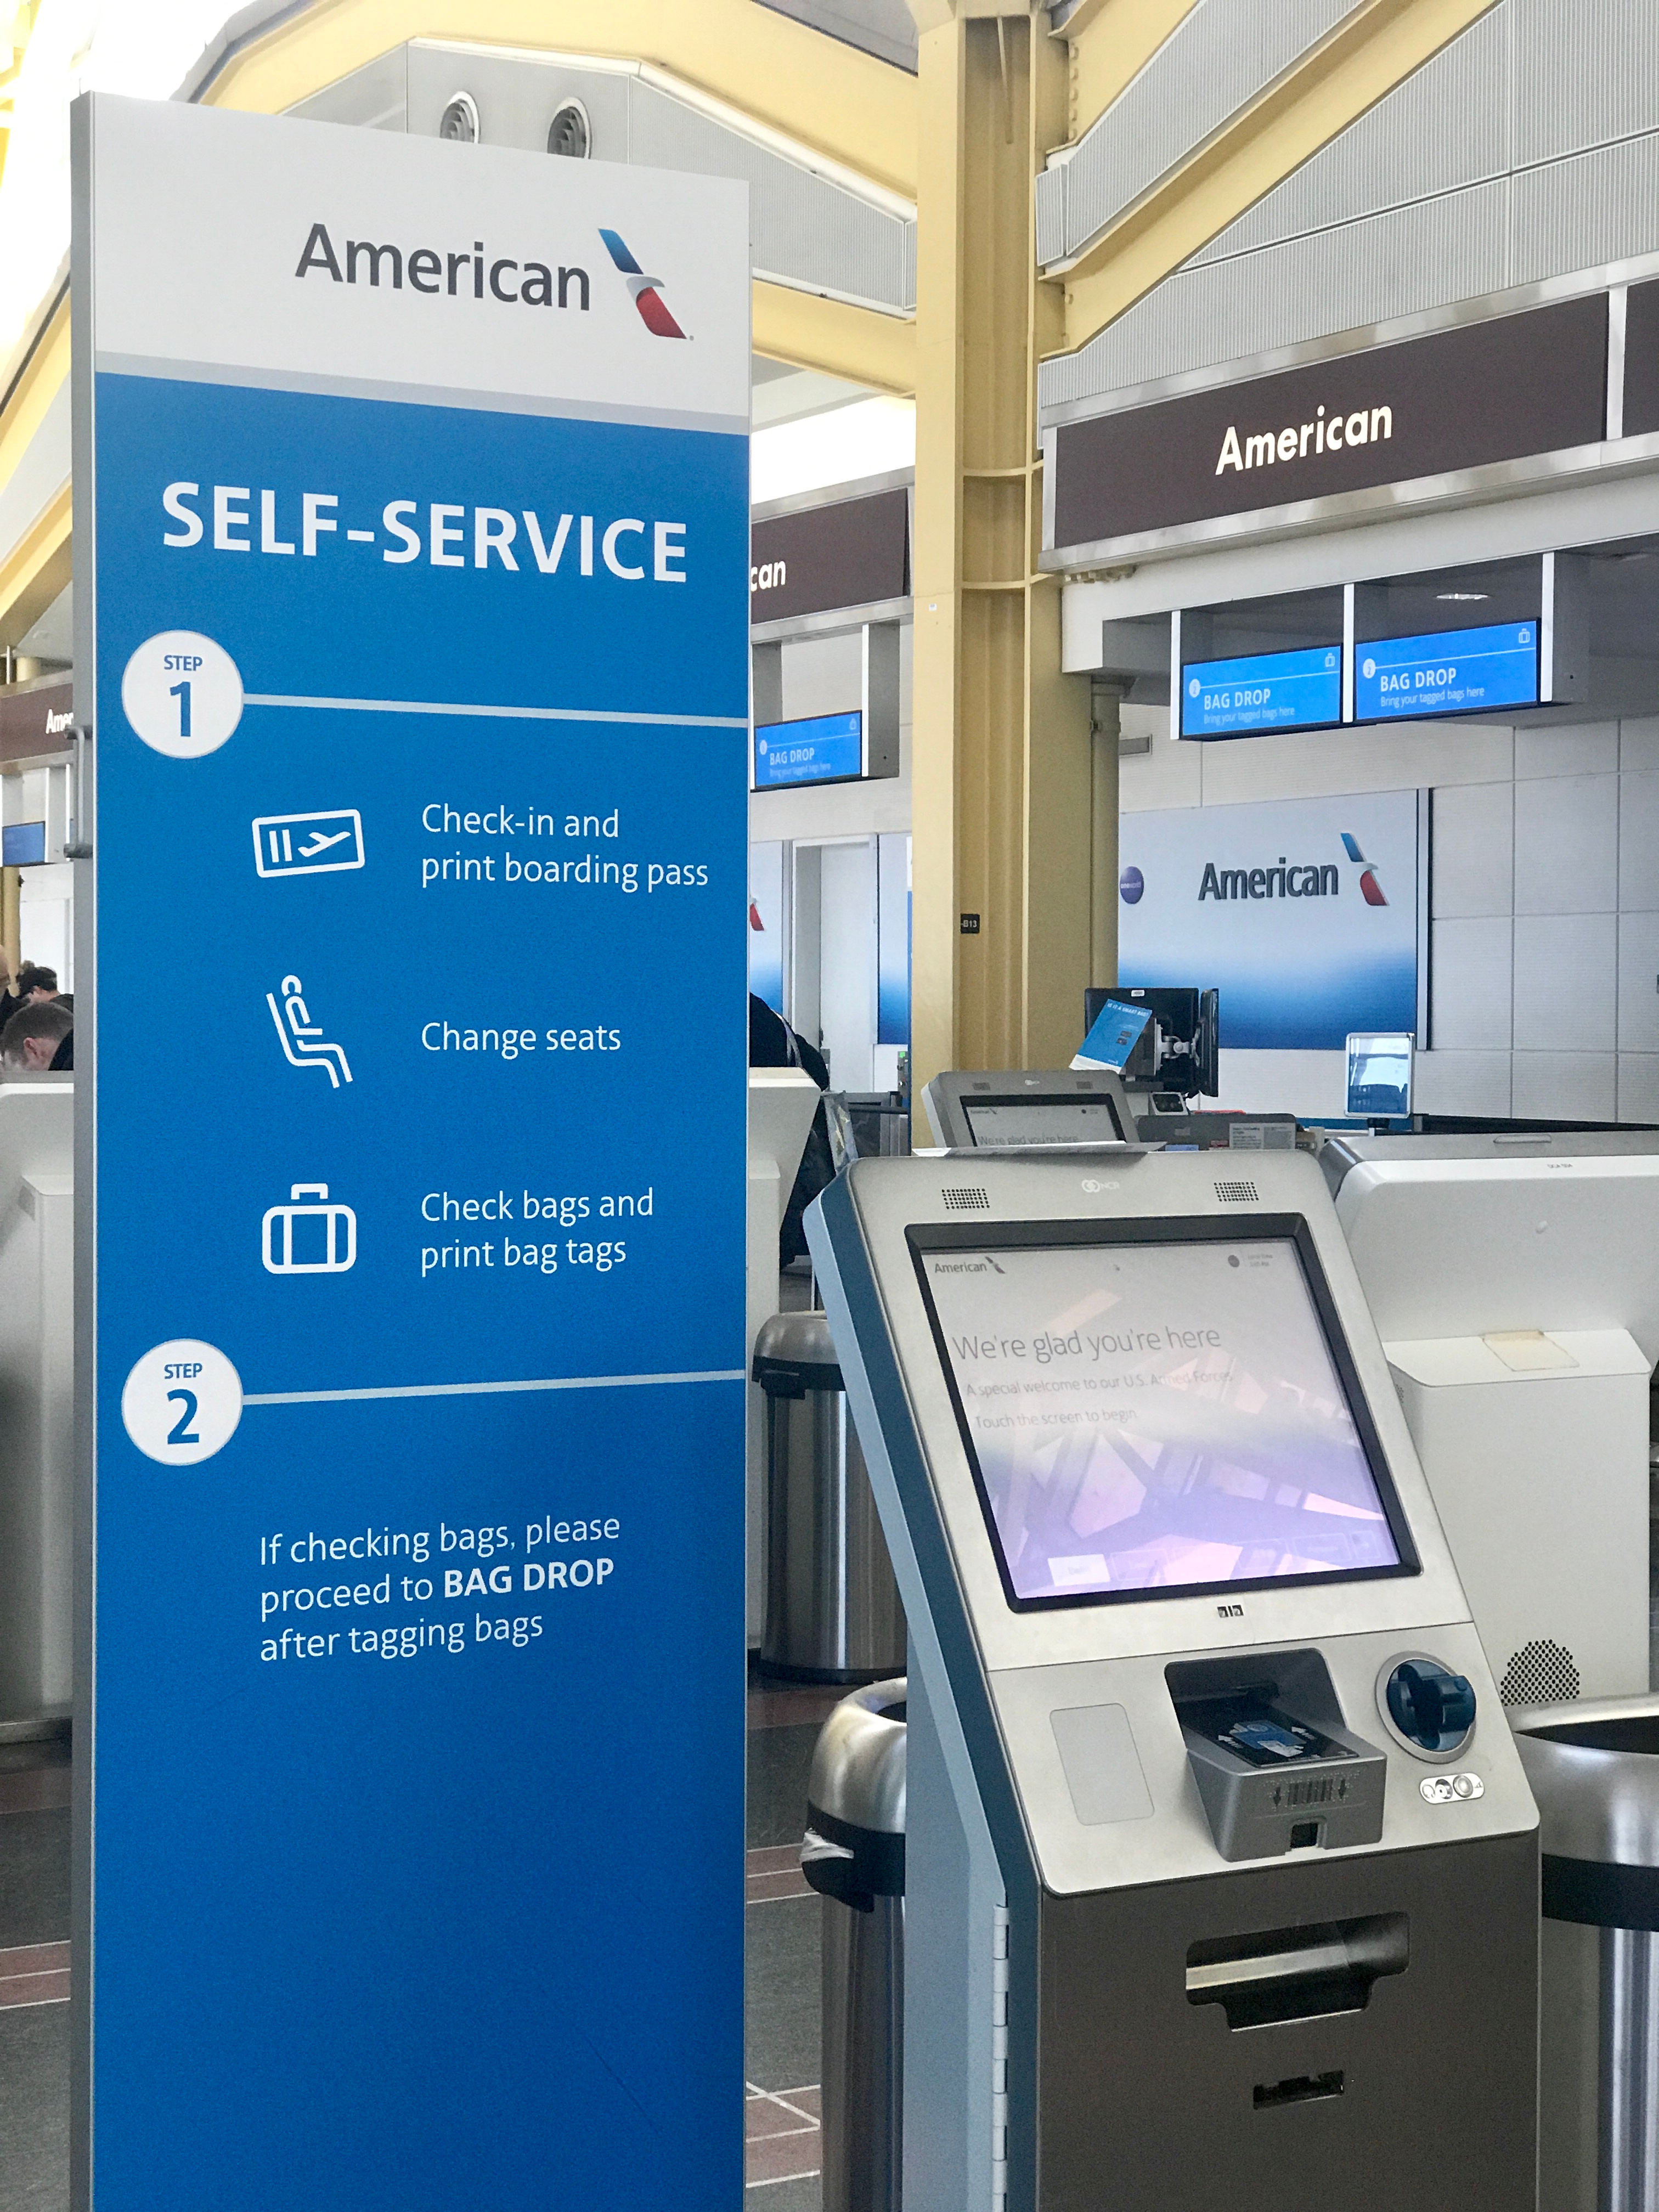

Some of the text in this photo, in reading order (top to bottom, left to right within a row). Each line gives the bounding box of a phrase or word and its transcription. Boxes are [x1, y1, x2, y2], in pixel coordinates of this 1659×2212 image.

[295, 223, 589, 311] American
[1216, 405, 1391, 475] American
[163, 482, 686, 582] SELF-SERVICE
[163, 654, 203, 672] STEP
[1380, 667, 1457, 692] BAG DROP
[170, 681, 191, 737] 1
[1204, 688, 1271, 710] BAG DROP
[1279, 706, 1295, 716] here
[1380, 687, 1485, 708] Bring your tagged bags here
[770, 747, 815, 766] BAG DROP
[422, 803, 618, 838] Check-in and
[422, 851, 708, 893] print boarding pass
[1198, 857, 1339, 901] American
[421, 1021, 621, 1060] Change seats
[421, 1187, 653, 1227] Check bags and
[422, 1237, 627, 1278] print bag tags
[935, 1261, 987, 1273] American
[952, 1326, 1222, 1364] We're glad you're here
[164, 1362, 203, 1380] STEP
[967, 1384, 977, 1396] A
[978, 1379, 1021, 1397] special
[1024, 1377, 1080, 1393] welcome
[1083, 1377, 1097, 1390] to
[1100, 1378, 1120, 1389] our
[1124, 1375, 1148, 1387] U.S.
[167, 1389, 200, 1445] 2
[975, 1408, 1136, 1429] Touch the screen to begin
[261, 1515, 620, 1565] If checking bags, please
[261, 1558, 614, 1623] proceed to BAG DROP
[261, 1612, 543, 1661] after tagging bags
